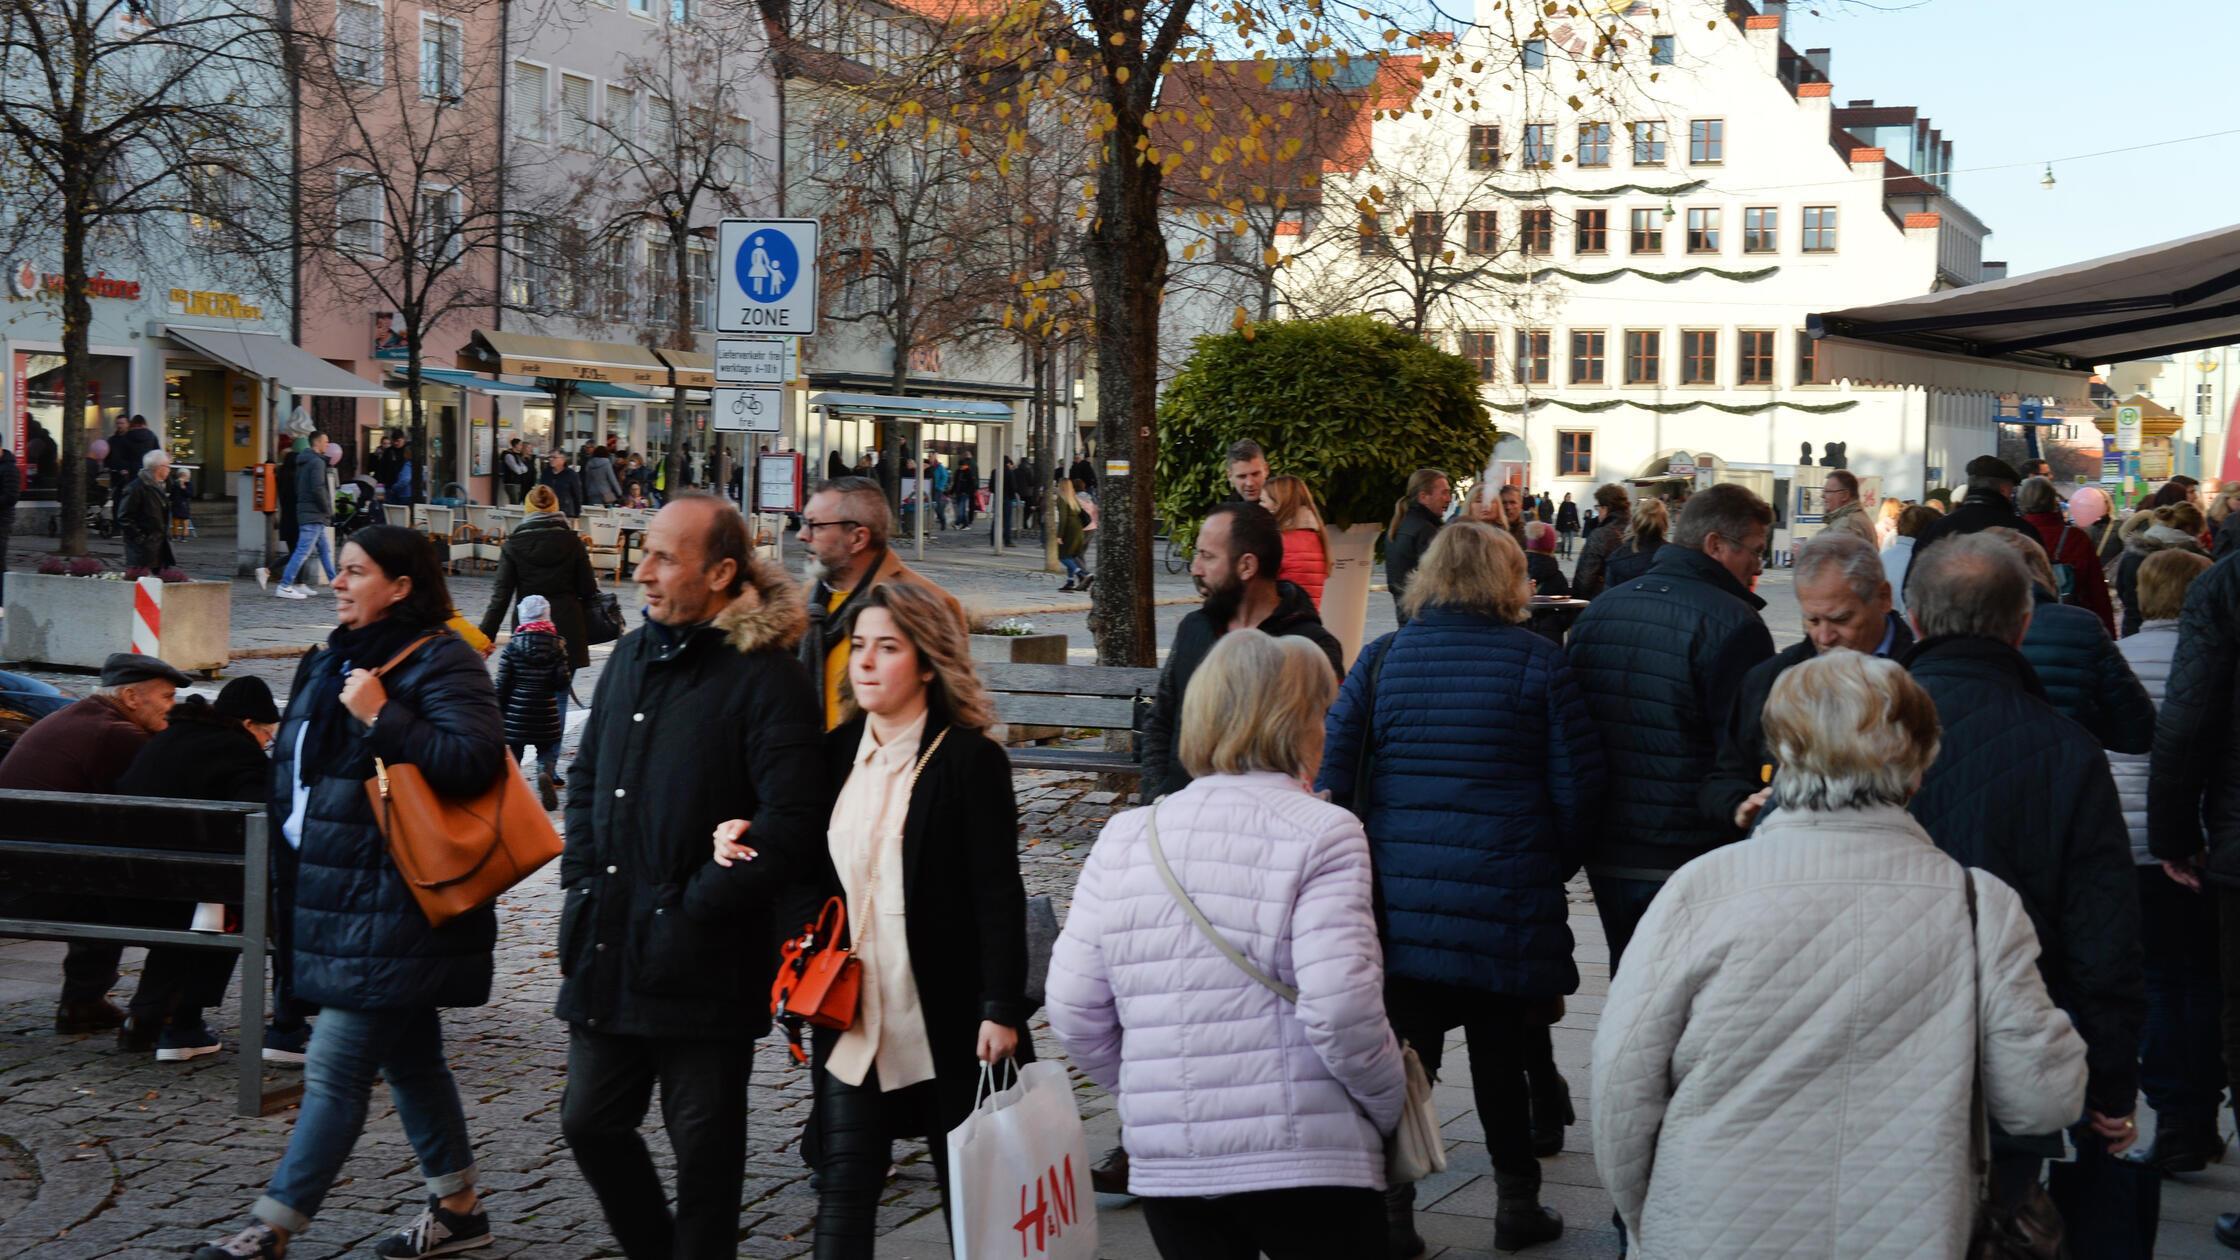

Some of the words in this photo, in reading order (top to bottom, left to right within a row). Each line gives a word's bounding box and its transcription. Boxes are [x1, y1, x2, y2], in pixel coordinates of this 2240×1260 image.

[41, 271, 141, 300] voafone
[740, 307, 790, 327] ZONE
[14, 370, 26, 402] Store
[14, 404, 26, 458] Business
[738, 417, 756, 428] frei
[1012, 1152, 1078, 1259] H&M
